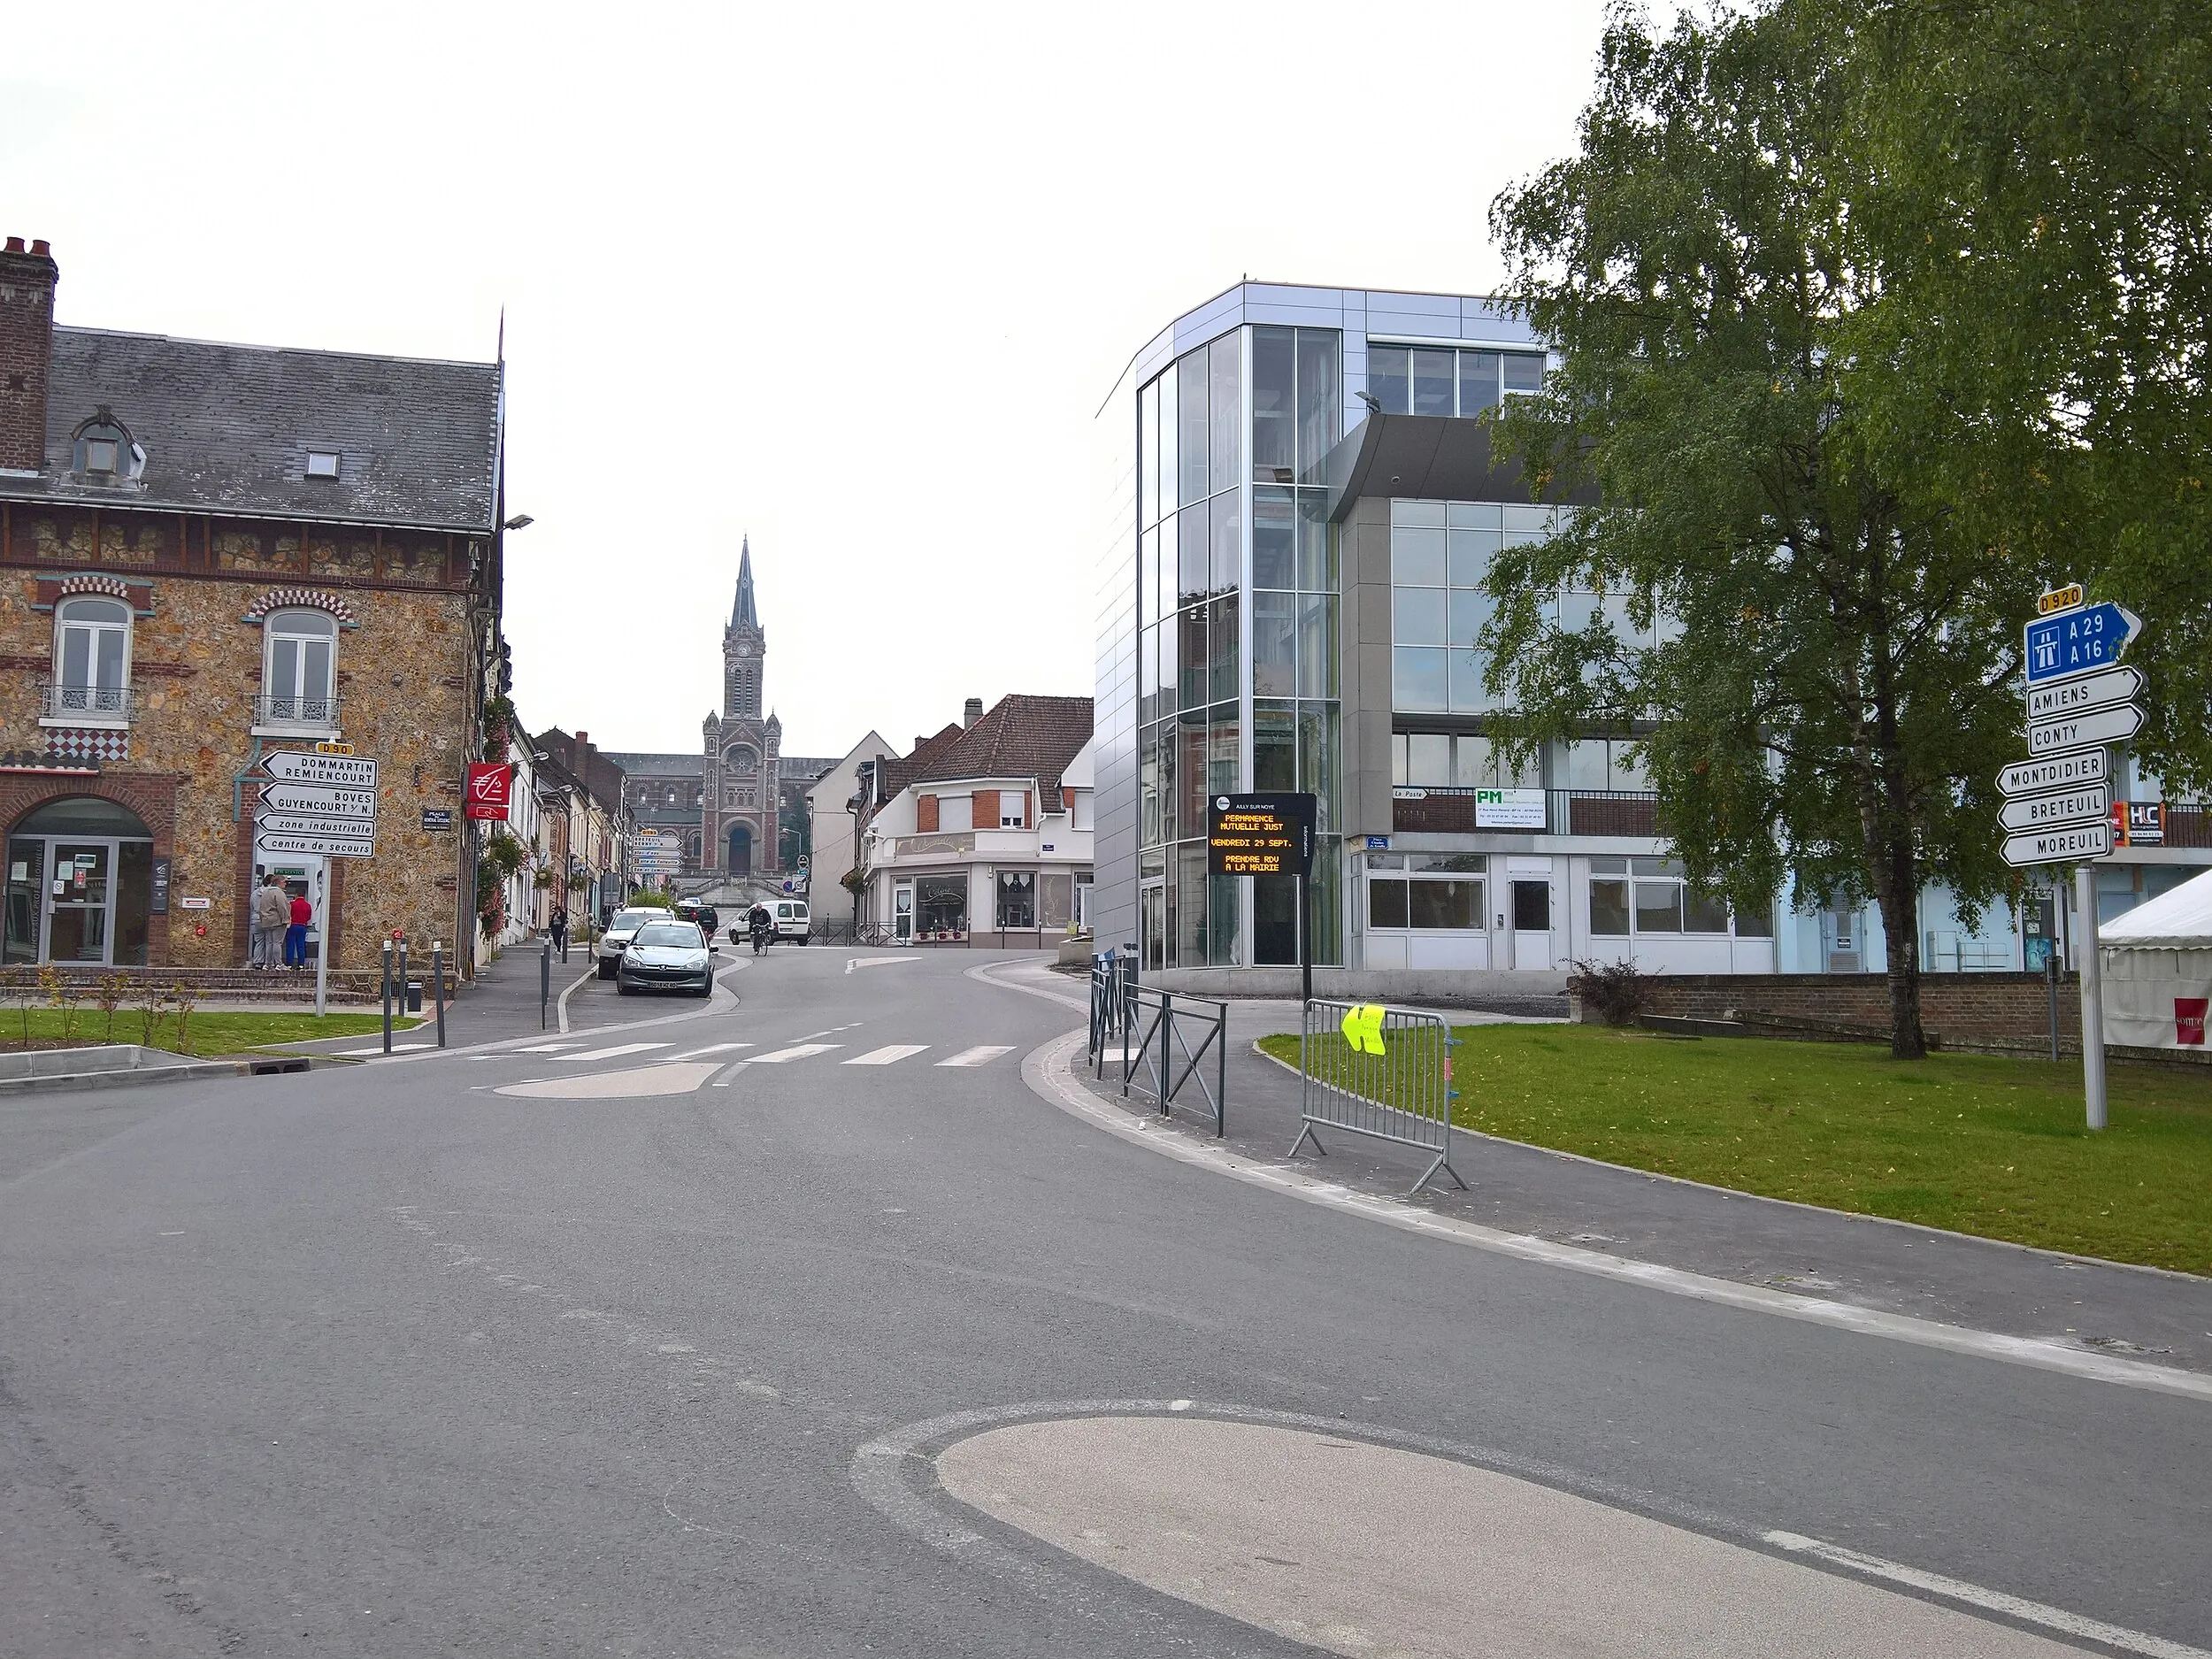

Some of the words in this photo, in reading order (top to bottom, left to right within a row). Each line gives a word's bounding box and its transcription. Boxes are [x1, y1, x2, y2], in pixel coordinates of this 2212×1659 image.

[2041, 598, 2048, 611] D
[2053, 588, 2079, 608] 920
[2070, 621, 2078, 640] A
[2084, 614, 2103, 635] 29
[2070, 645, 2079, 664] A
[2085, 640, 2102, 660] 16
[2034, 686, 2089, 710] AMIENS
[2035, 725, 2078, 746] CONTY
[334, 745, 348, 754] 90
[301, 758, 373, 772] DOMMARTIN
[2010, 758, 2100, 787] MONTDIDIER
[285, 768, 372, 783] REMIENCOURT
[278, 798, 347, 812] GUYENCOURT
[334, 792, 372, 803] BOVES
[1477, 790, 1502, 803] PM
[2031, 795, 2101, 819] BRETEUIL
[309, 821, 371, 833] industrielle
[272, 840, 306, 849] centre
[329, 843, 370, 853] secours
[2037, 832, 2101, 855] MOREUIL
